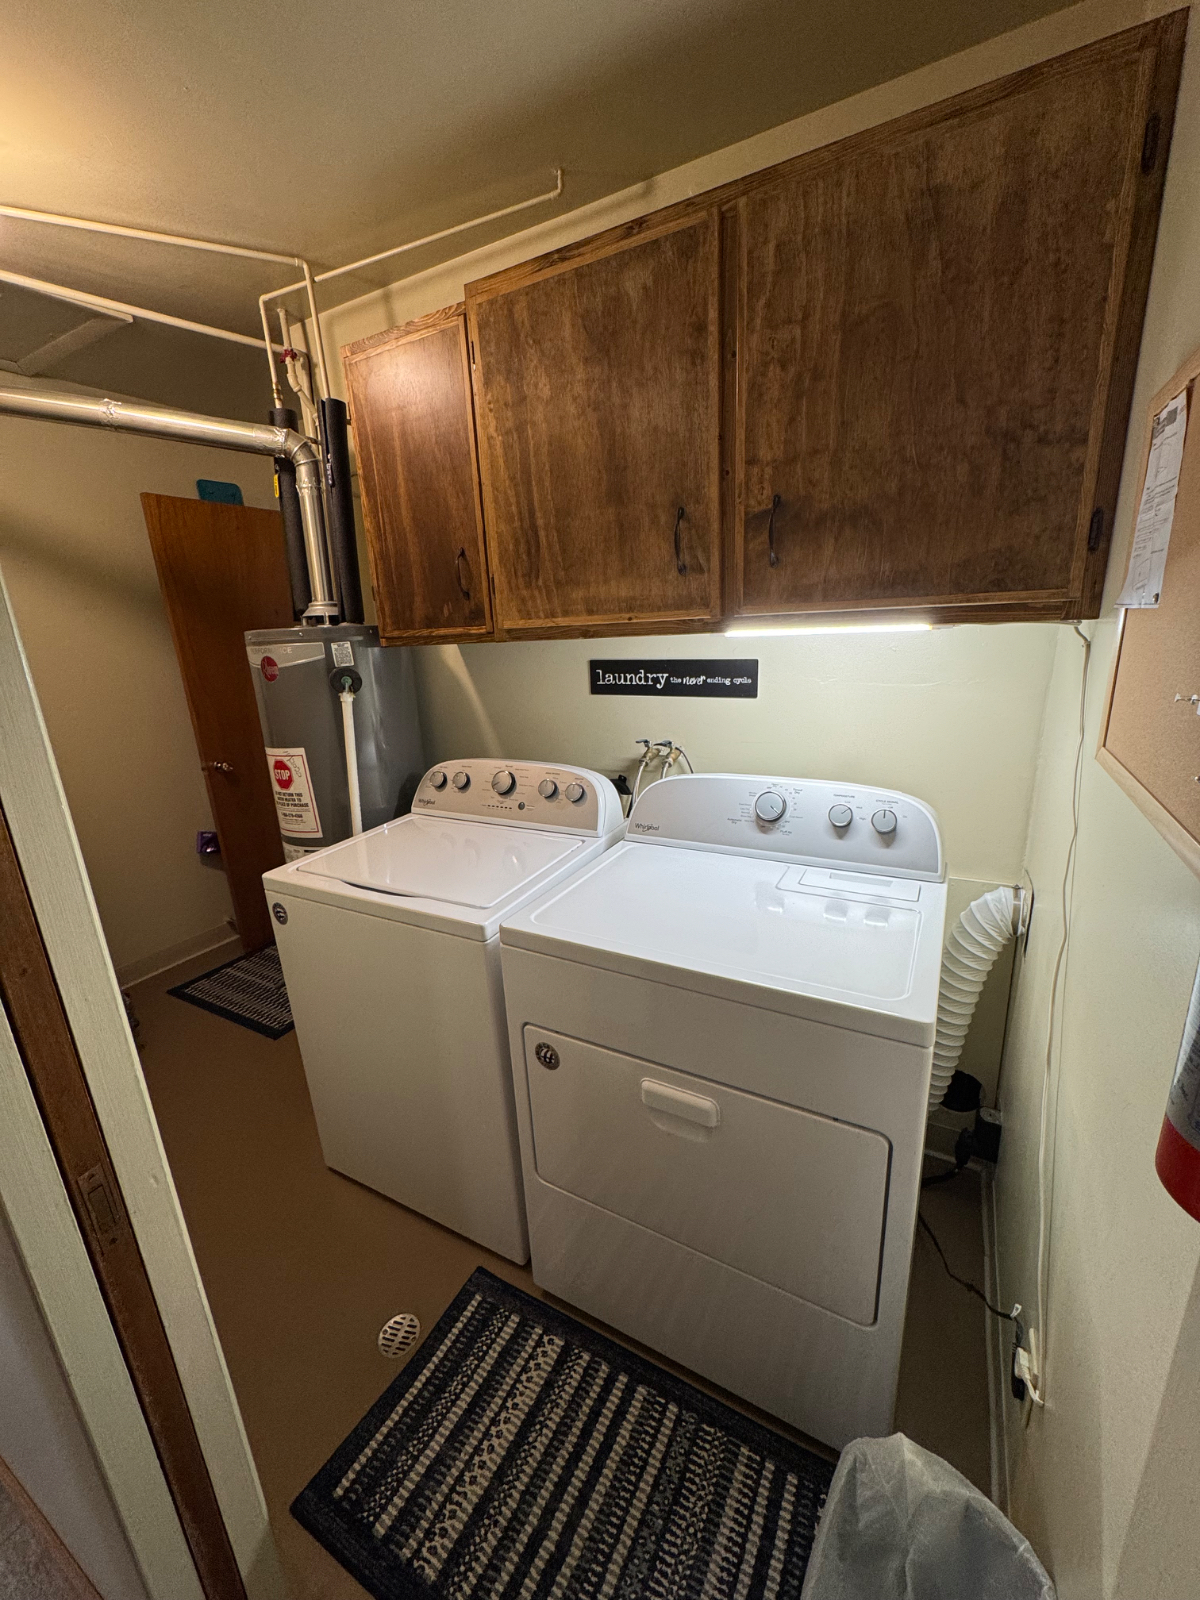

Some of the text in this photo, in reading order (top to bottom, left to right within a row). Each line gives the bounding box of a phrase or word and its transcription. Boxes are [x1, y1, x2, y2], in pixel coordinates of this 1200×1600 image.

[596, 669, 669, 689] laundry
[683, 675, 706, 685] never
[706, 677, 732, 686] ending
[732, 677, 752, 685] cycle
[274, 769, 290, 780] STOP
[634, 822, 660, 833] Whirlpool
